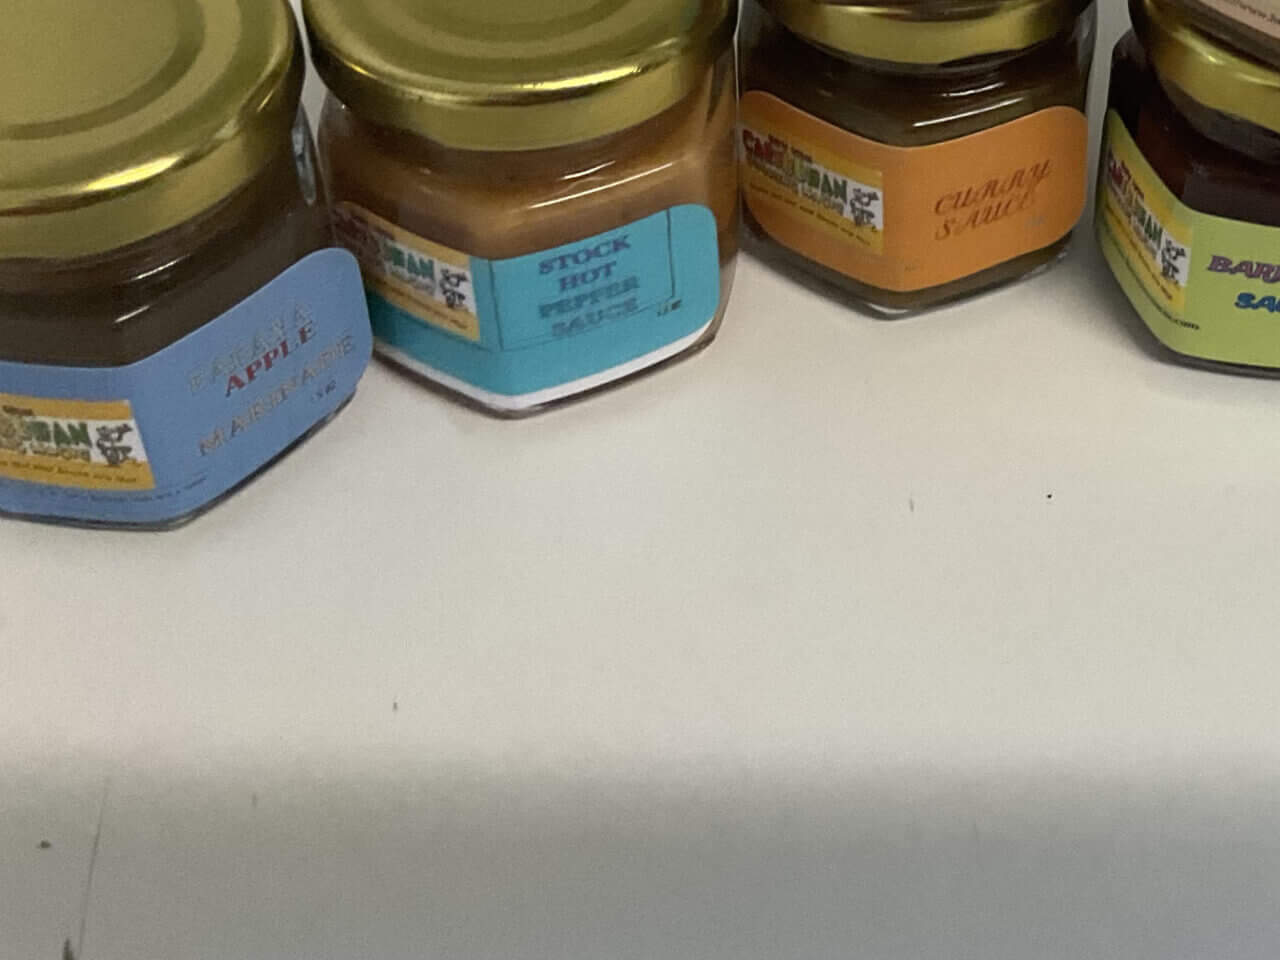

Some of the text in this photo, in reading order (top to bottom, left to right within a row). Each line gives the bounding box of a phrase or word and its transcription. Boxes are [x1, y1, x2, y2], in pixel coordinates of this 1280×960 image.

[538, 234, 631, 275] STOCK
[560, 260, 617, 291] HOT
[538, 276, 640, 319] PEPPER
[225, 318, 317, 397] APPLE
